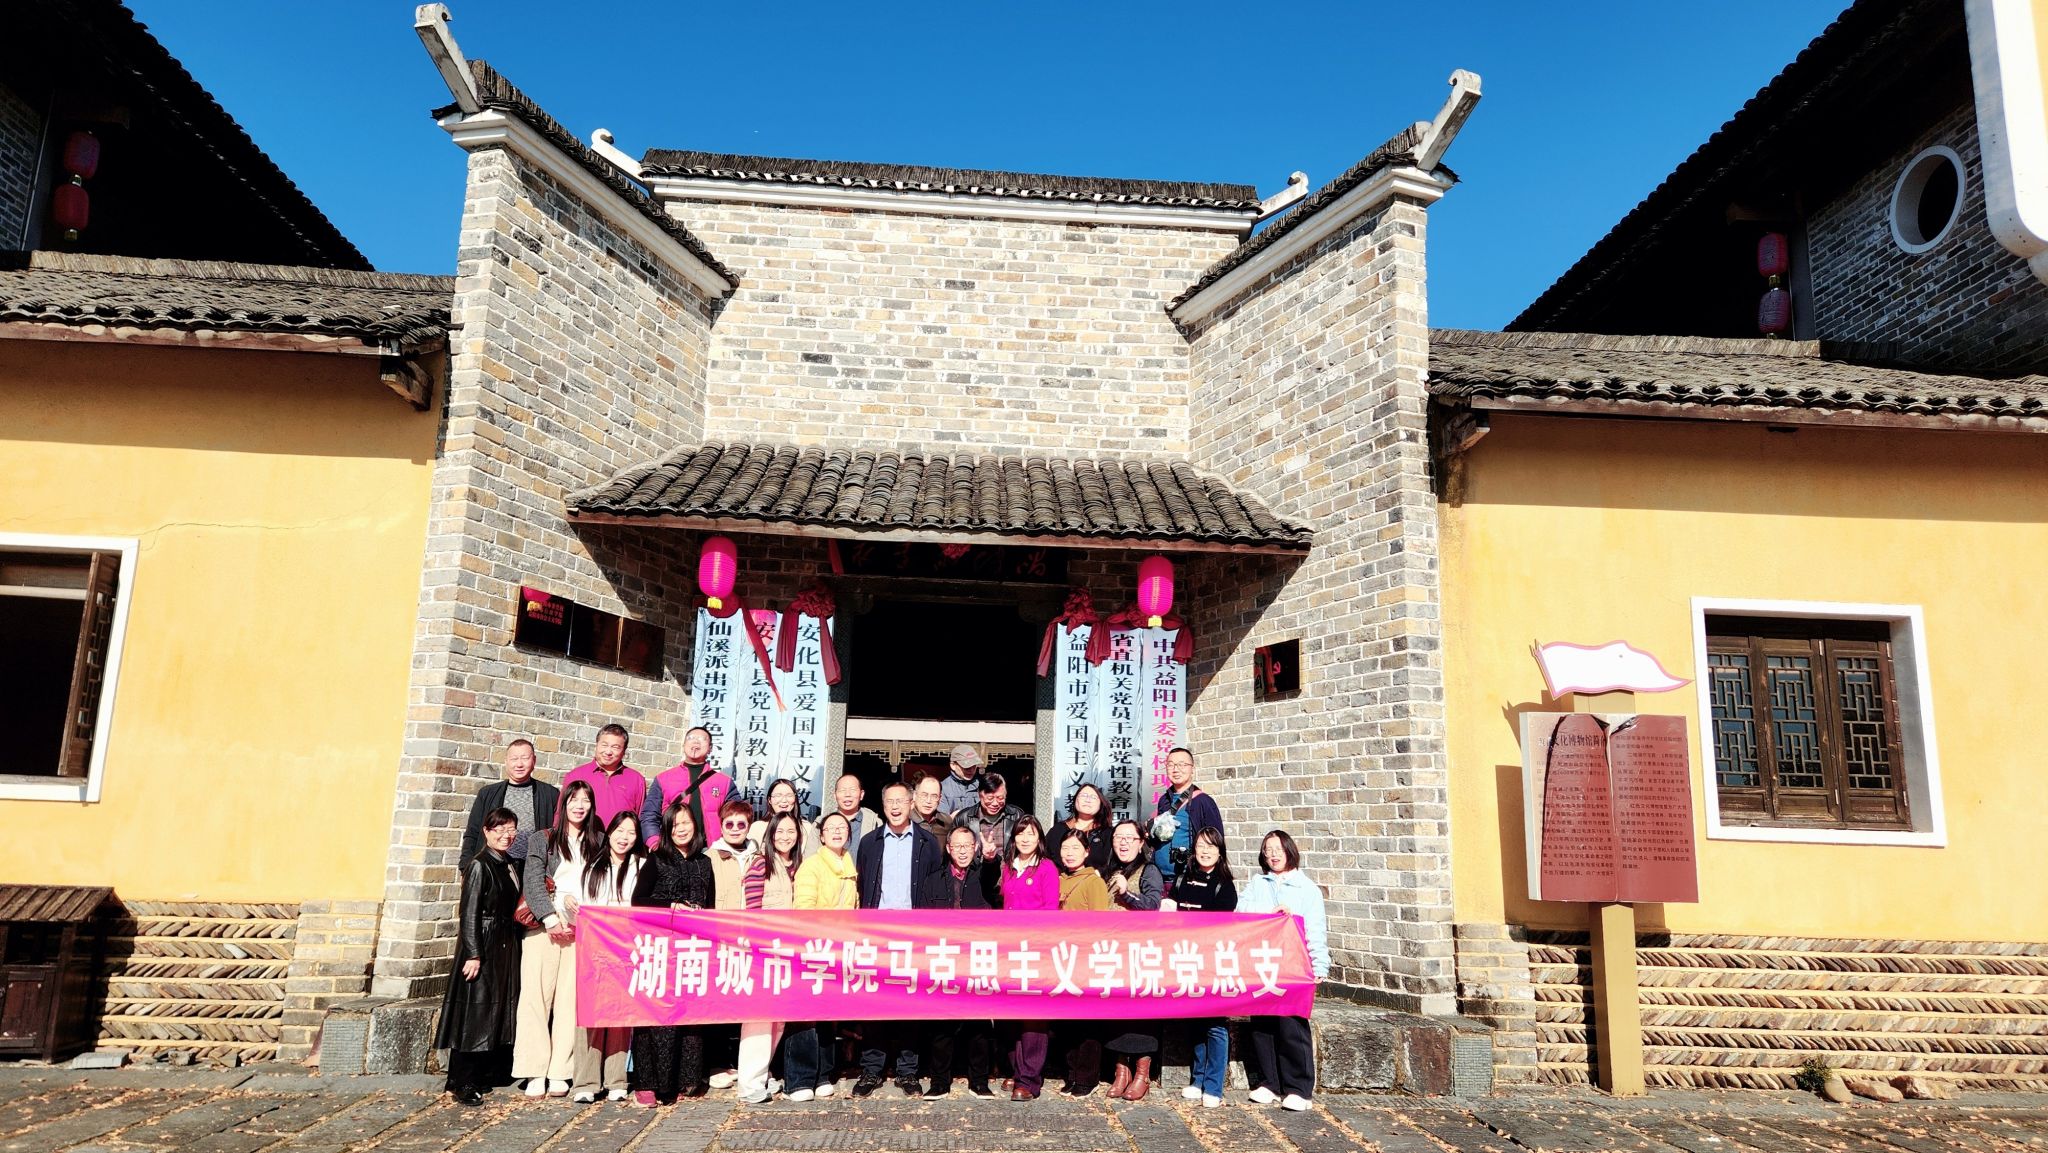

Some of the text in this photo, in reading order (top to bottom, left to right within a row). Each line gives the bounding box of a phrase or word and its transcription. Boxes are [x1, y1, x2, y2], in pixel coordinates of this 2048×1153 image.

[627, 931, 1288, 1000] 湖南城市学院马克思主义学院党总支
